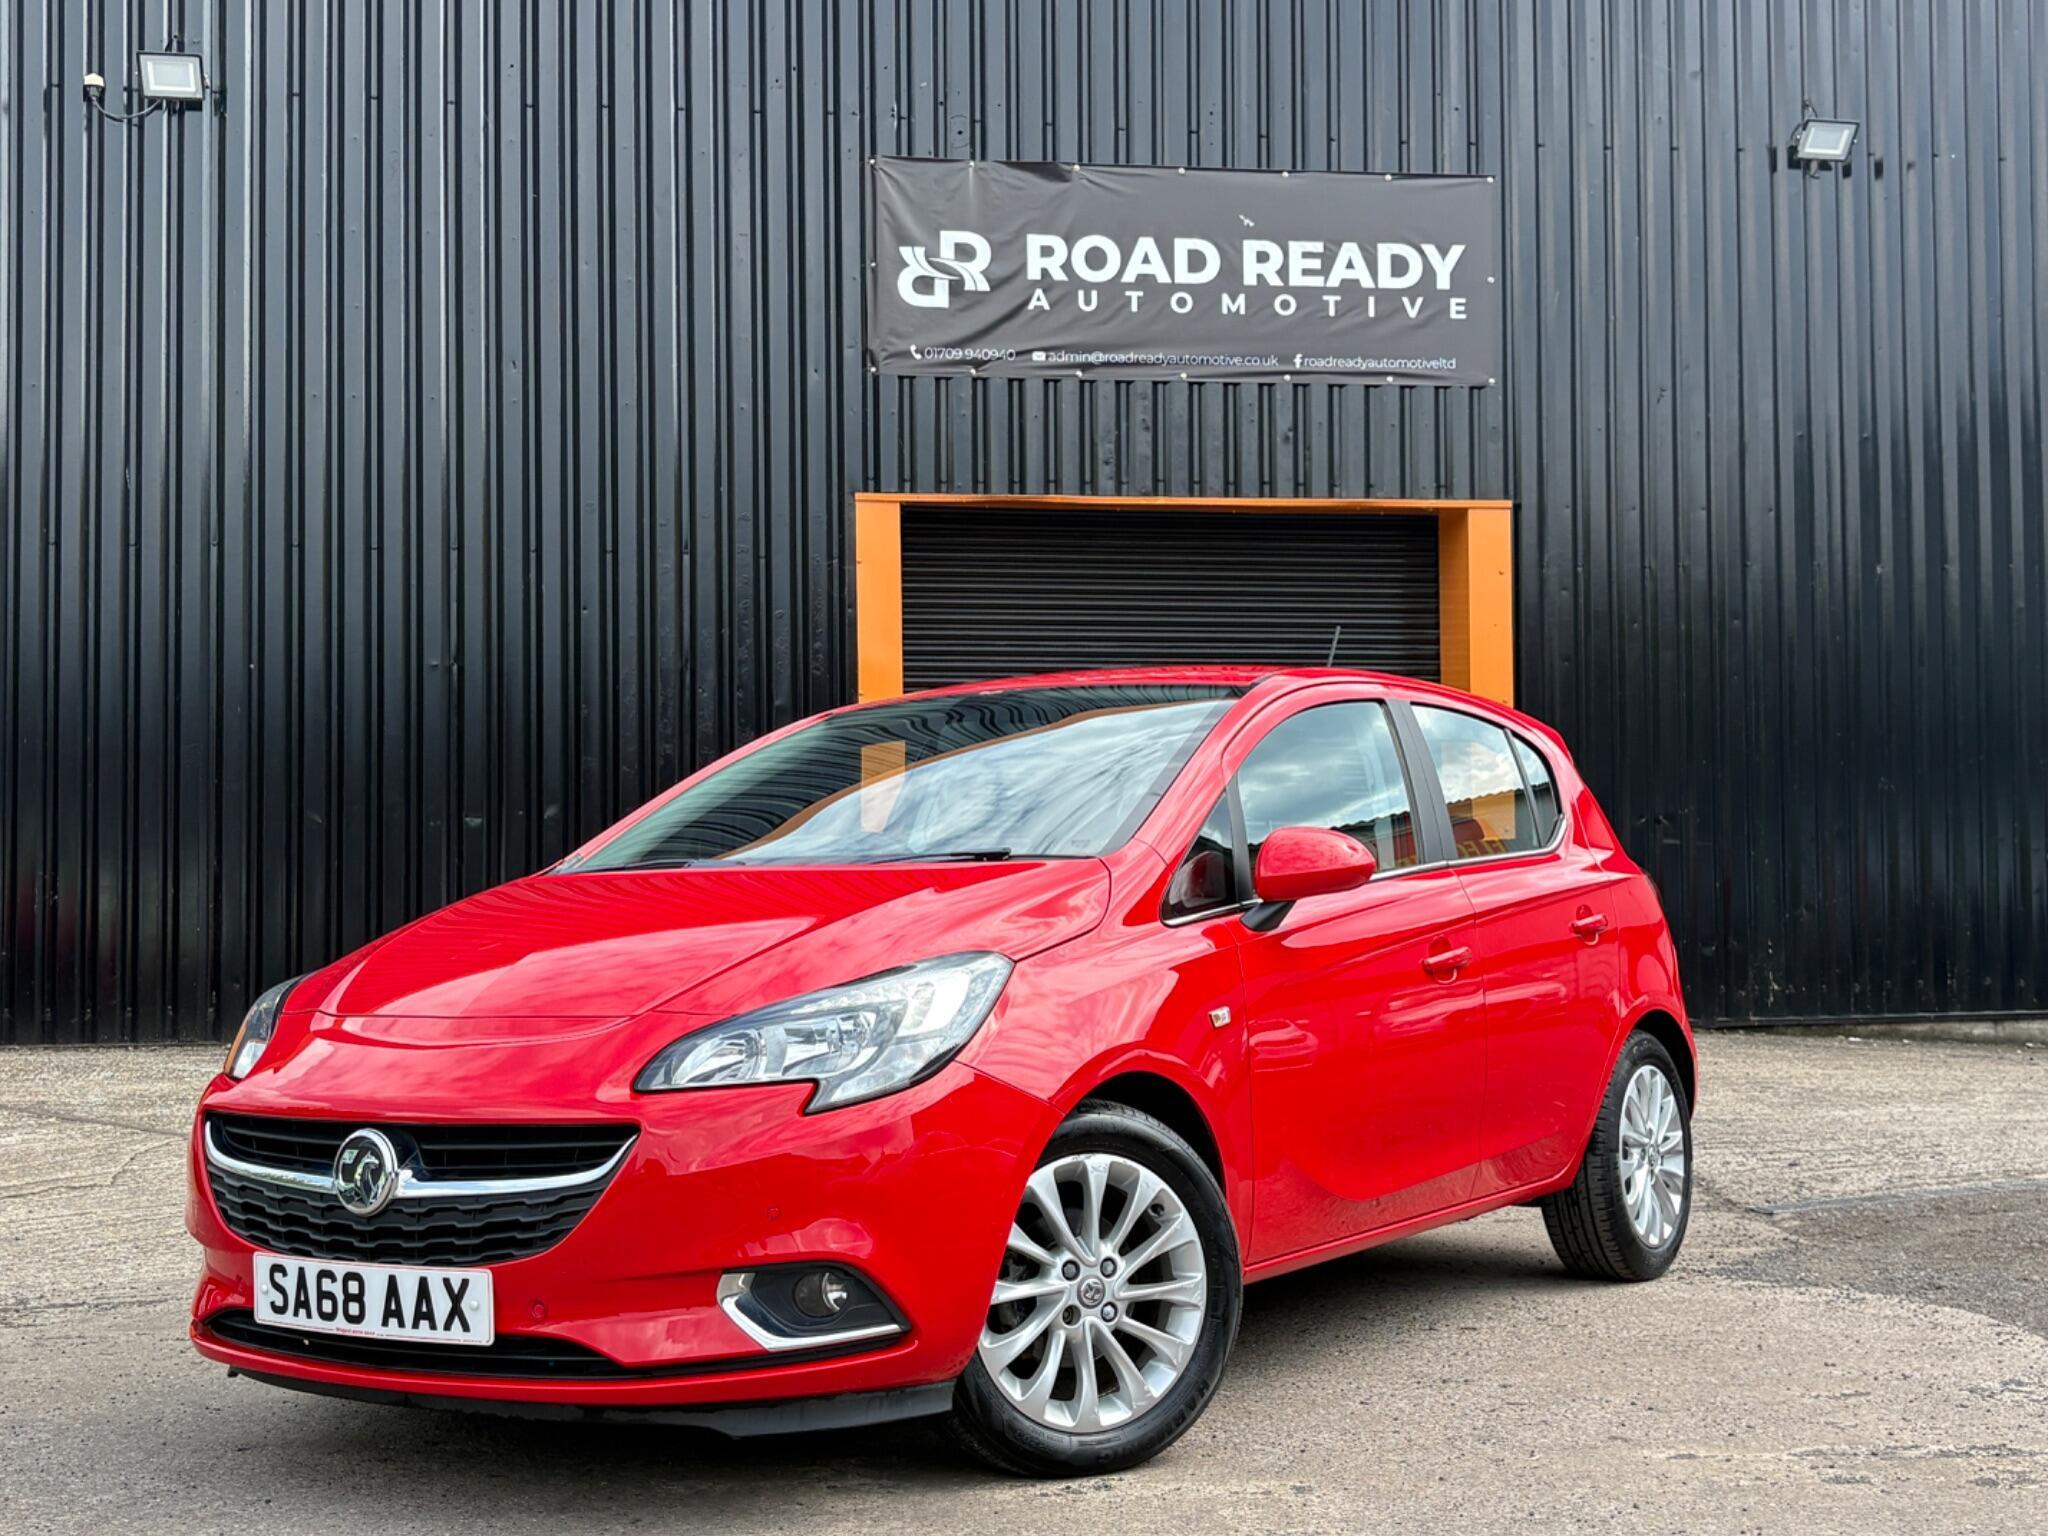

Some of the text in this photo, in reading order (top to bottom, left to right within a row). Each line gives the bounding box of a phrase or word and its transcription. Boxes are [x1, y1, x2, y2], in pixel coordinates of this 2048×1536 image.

[1026, 233, 1466, 290] ROAD READY
[1027, 288, 1467, 319] AUTOMOTIVE
[924, 346, 1017, 362] 01709 940940
[1048, 351, 1279, 366] admin@roadreadyautomotive.co.uk
[1304, 355, 1457, 371] roadreadyautomotiveltd
[269, 1263, 471, 1333] SA68 AAX
